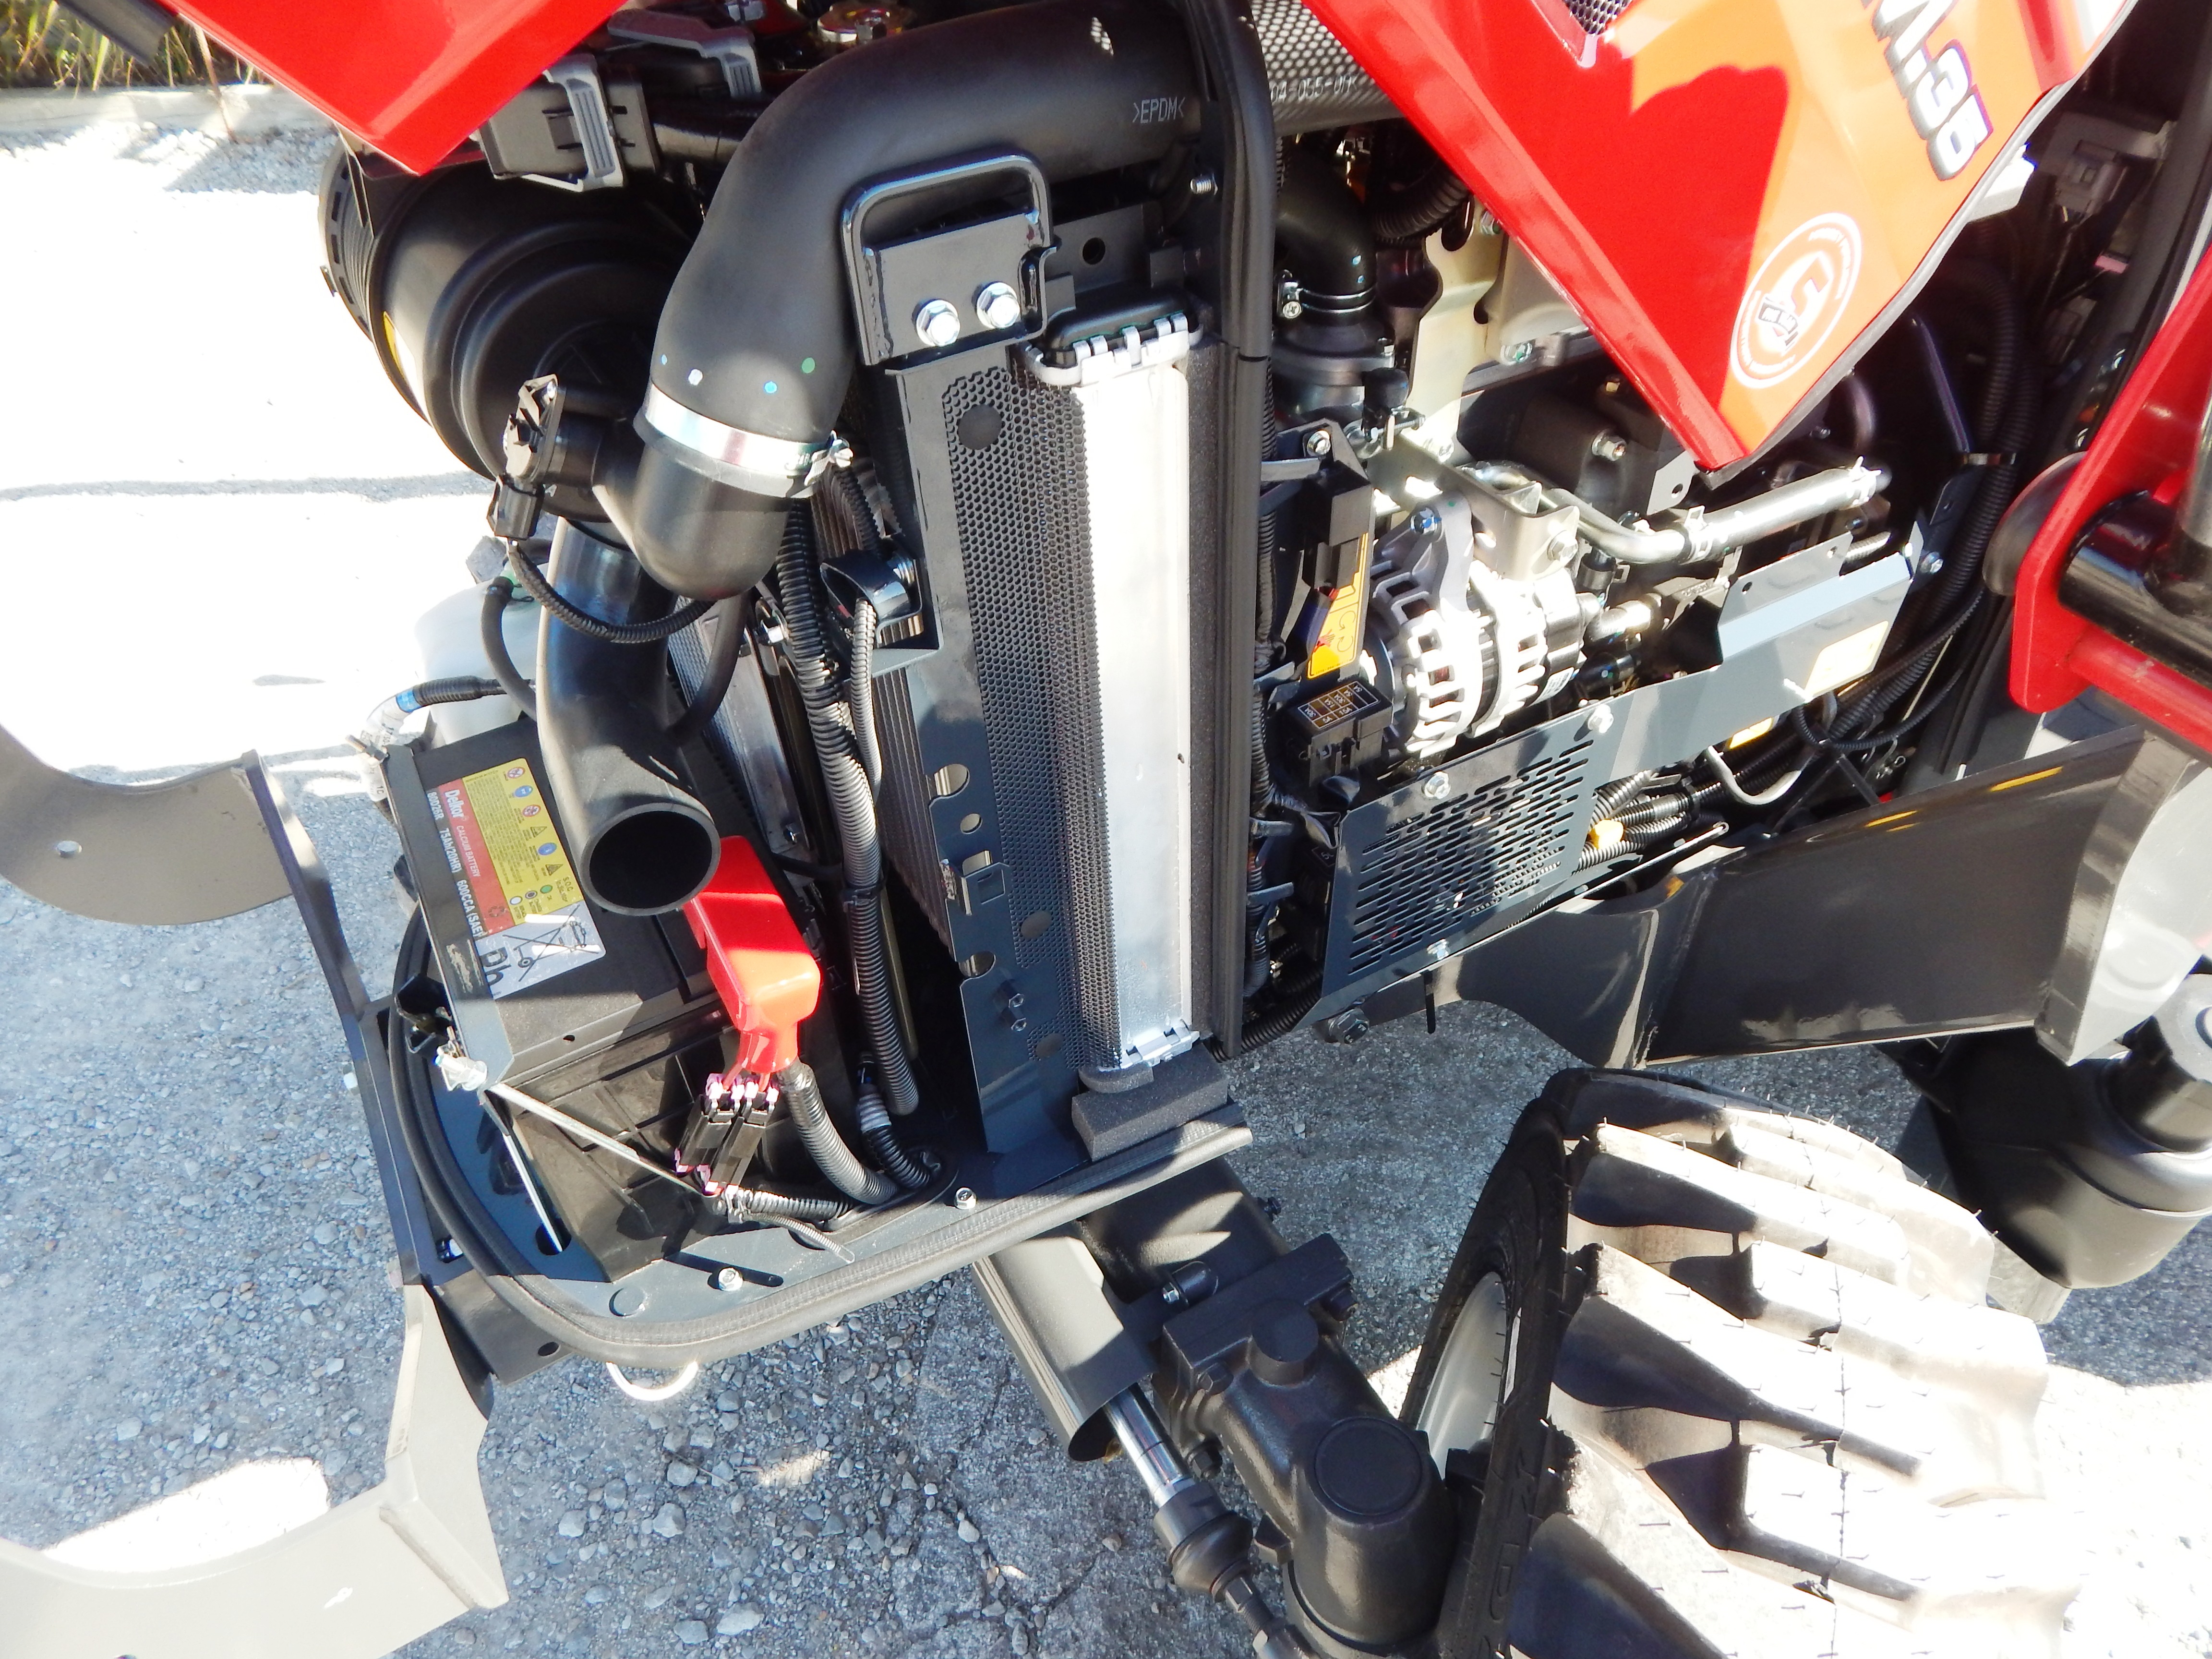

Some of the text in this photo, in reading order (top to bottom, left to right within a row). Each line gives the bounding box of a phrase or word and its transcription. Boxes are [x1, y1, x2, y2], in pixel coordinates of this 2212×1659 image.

[444, 789, 467, 817] Delkor
[456, 825, 481, 877] CALCIUM BATTERY
[456, 878, 476, 913] 600CCA
